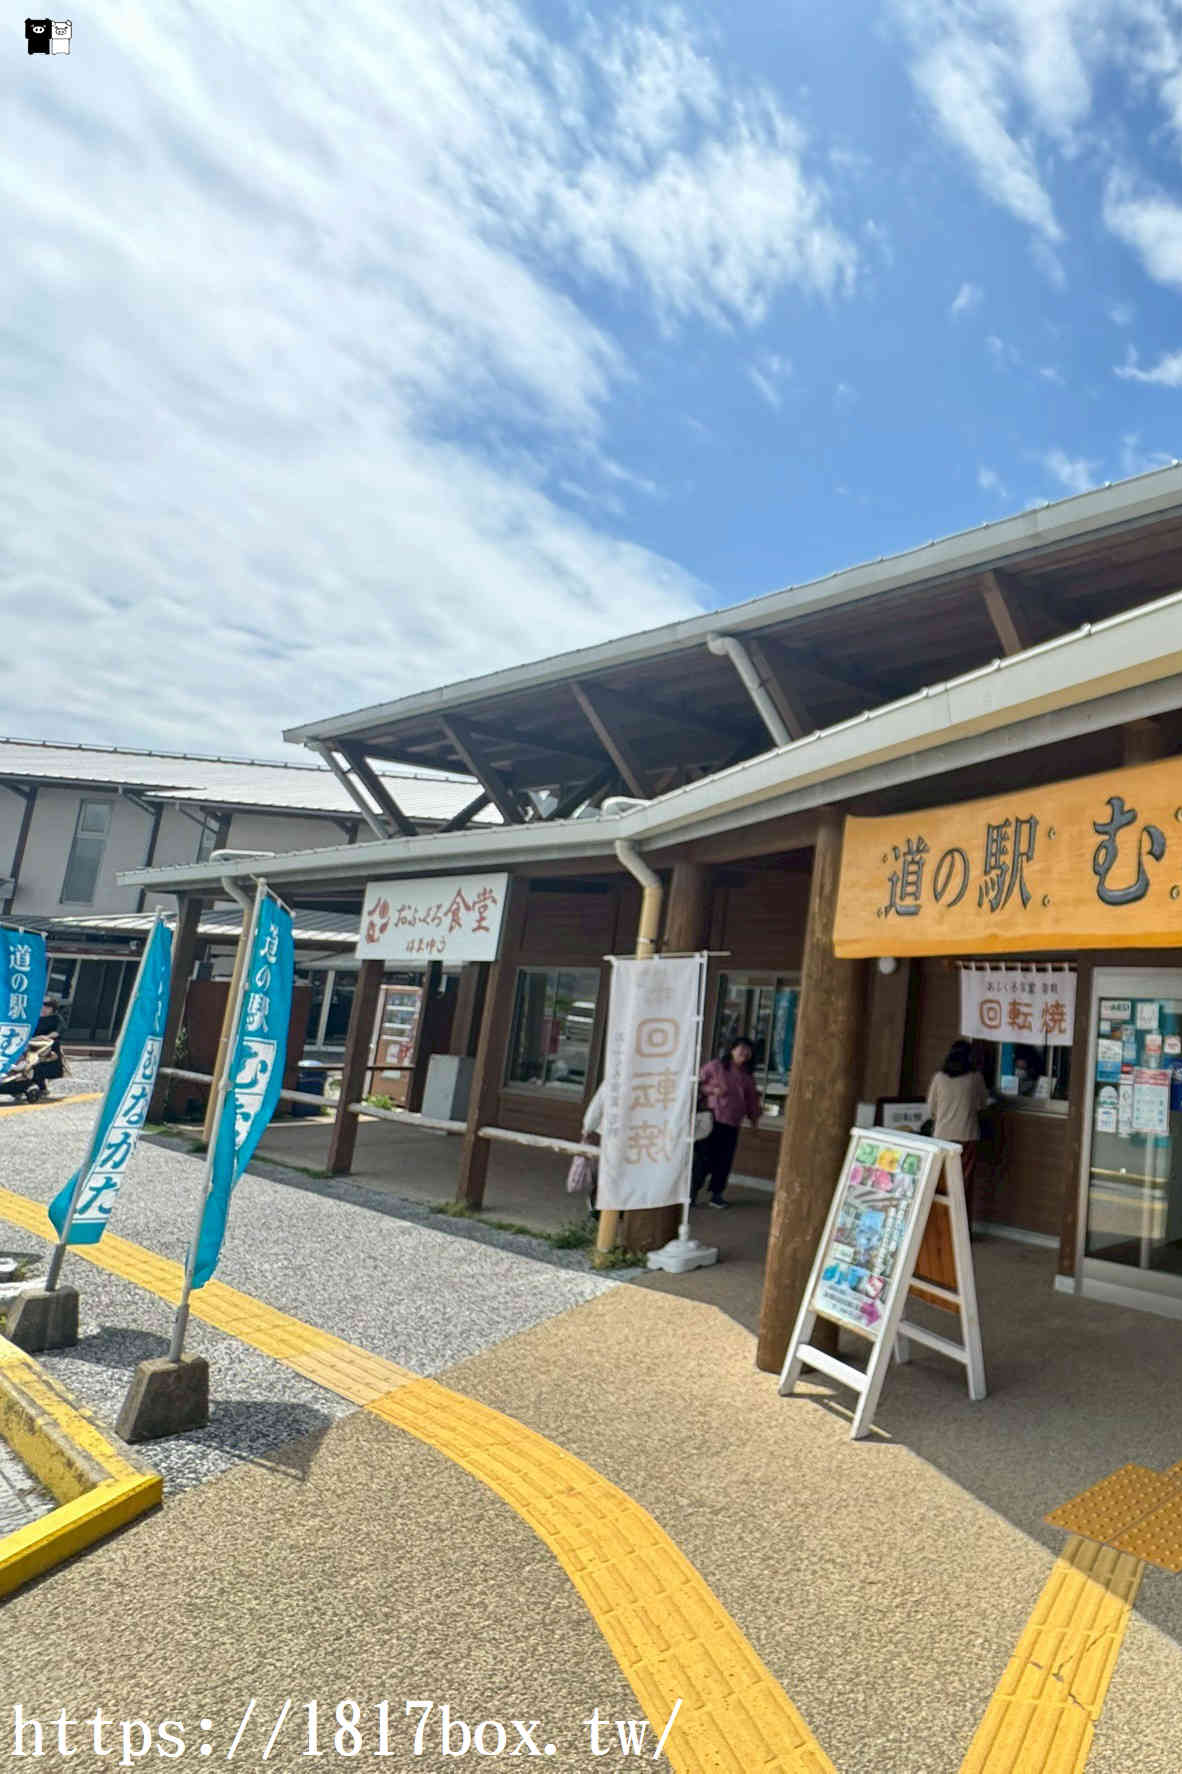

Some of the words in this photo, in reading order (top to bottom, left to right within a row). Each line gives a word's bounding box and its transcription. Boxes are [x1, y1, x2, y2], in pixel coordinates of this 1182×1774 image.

[883, 816, 1038, 916] 道の駅
[8, 944, 32, 1020] 道の駅
[245, 923, 280, 1033] 道の駅
[979, 998, 1067, 1034] 回転焼
